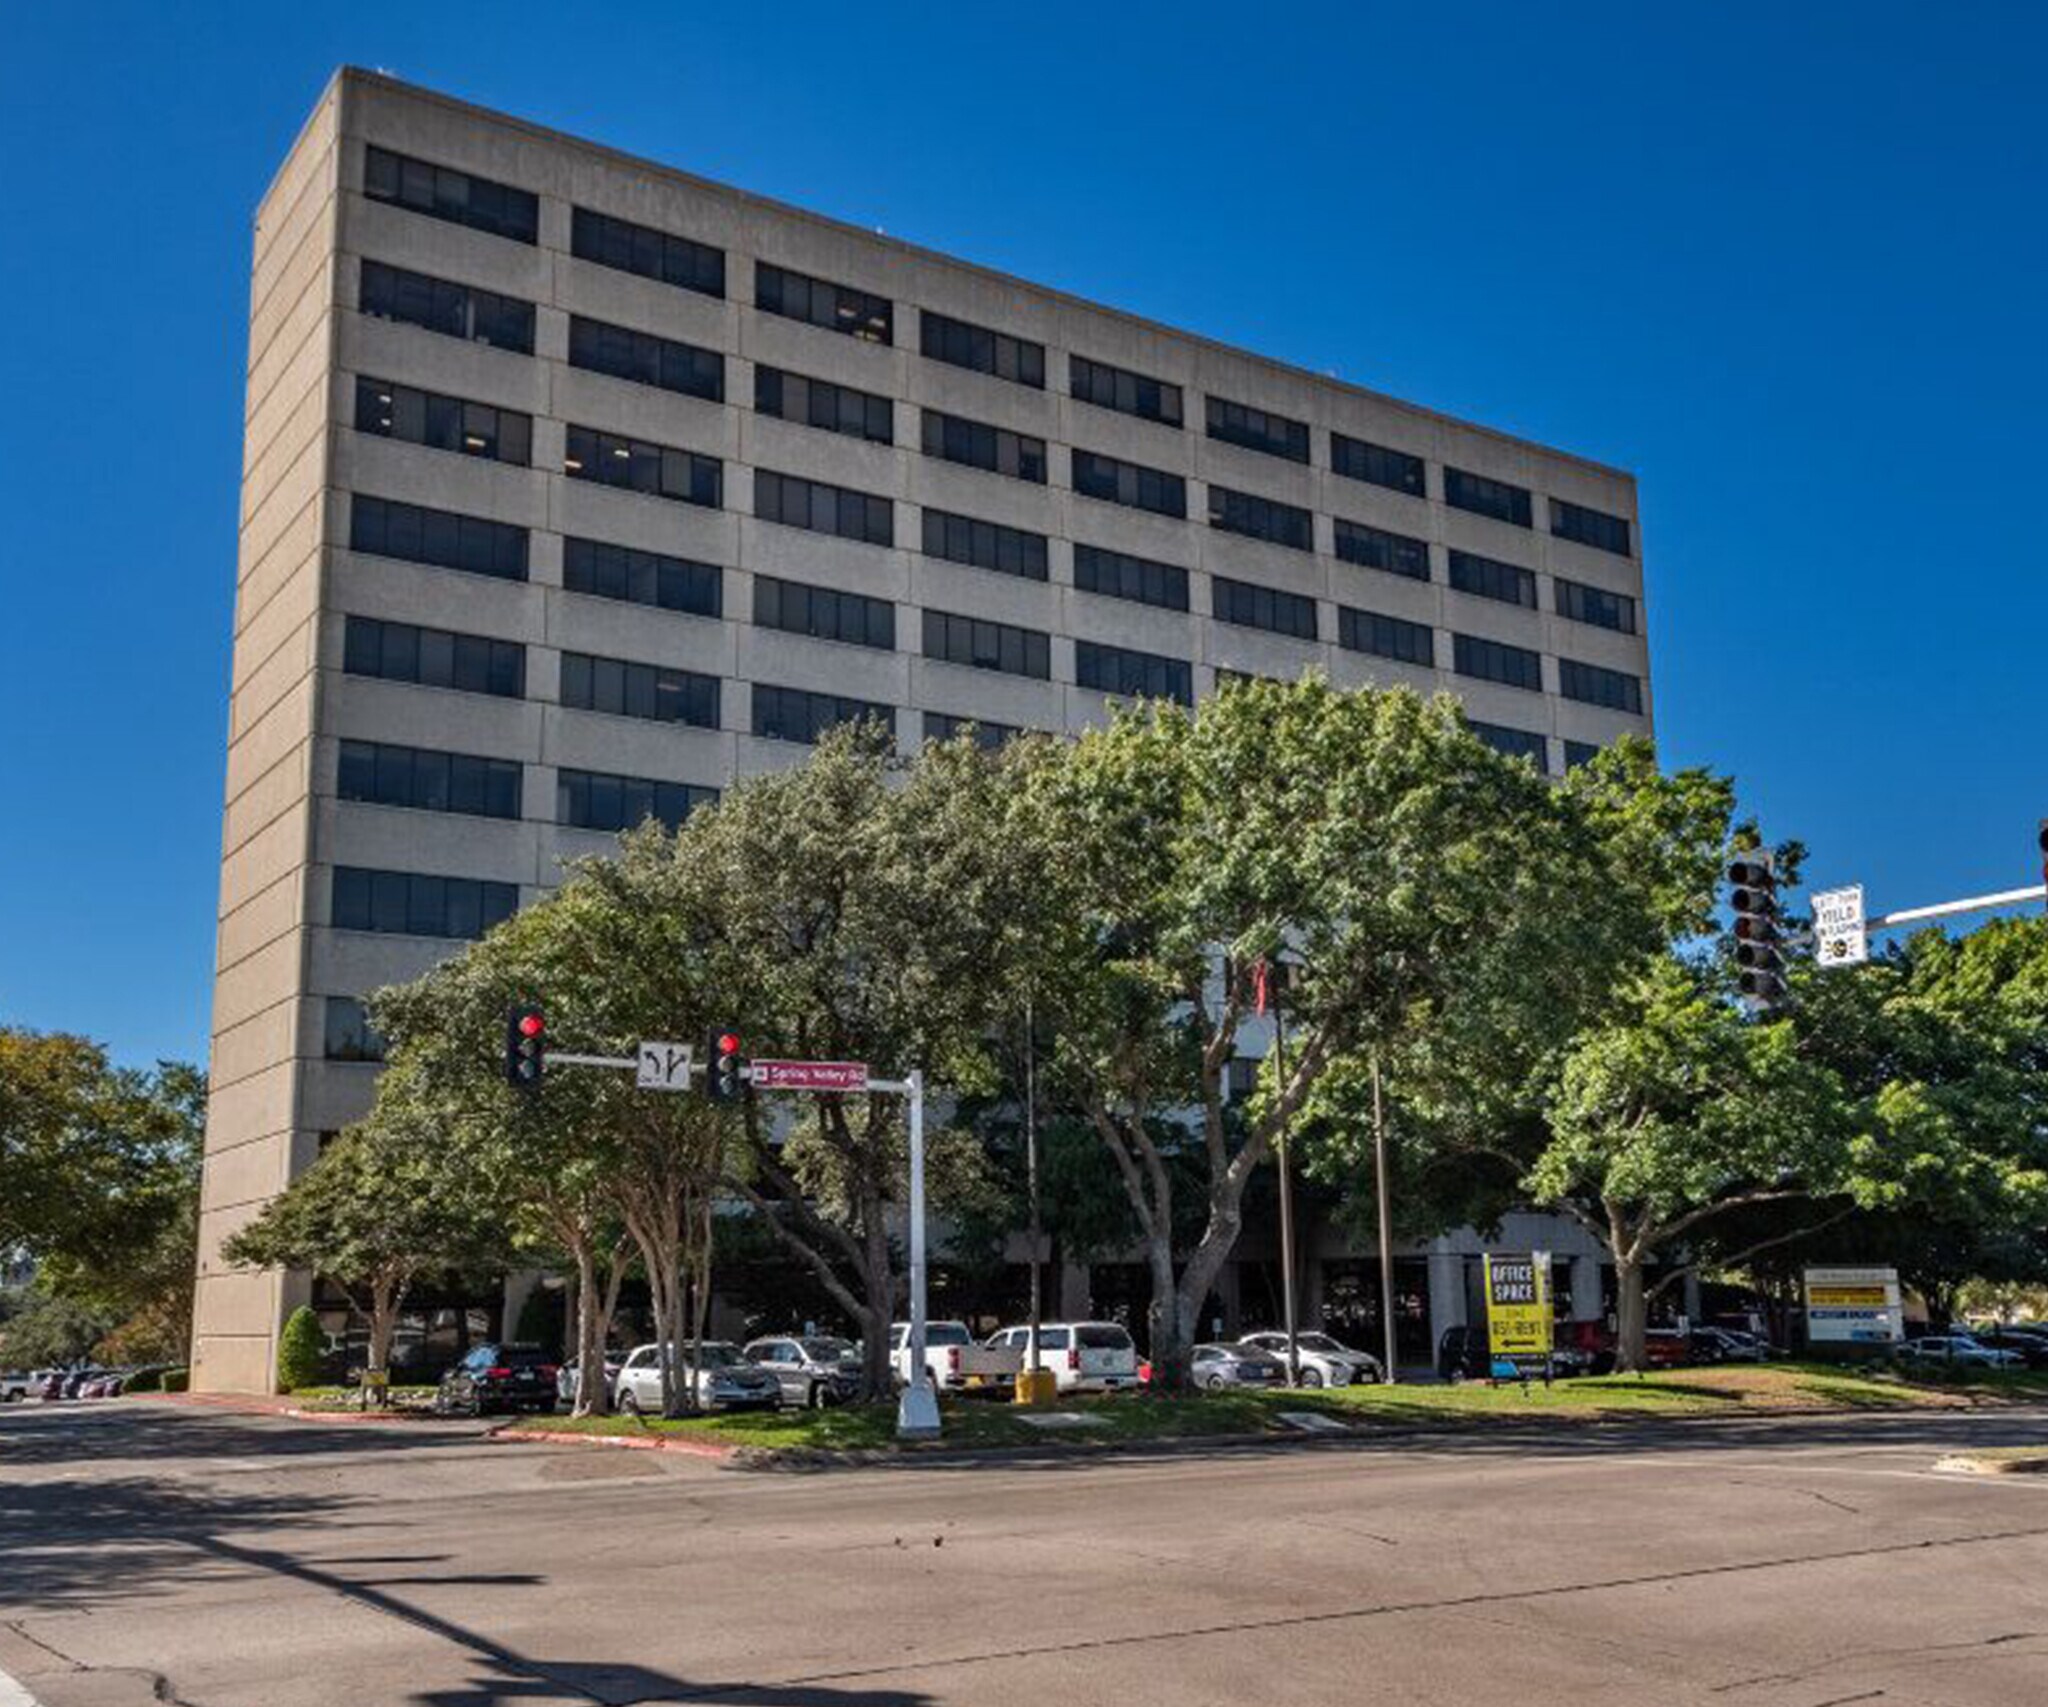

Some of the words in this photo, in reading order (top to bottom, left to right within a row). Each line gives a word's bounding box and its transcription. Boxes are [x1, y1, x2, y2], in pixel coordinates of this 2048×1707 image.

[1822, 905, 1857, 924] YIELD
[771, 1066, 808, 1083] Spring
[812, 1069, 847, 1083] Valley
[1492, 1265, 1533, 1282] OFFICE
[1494, 1284, 1533, 1301] SPACE
